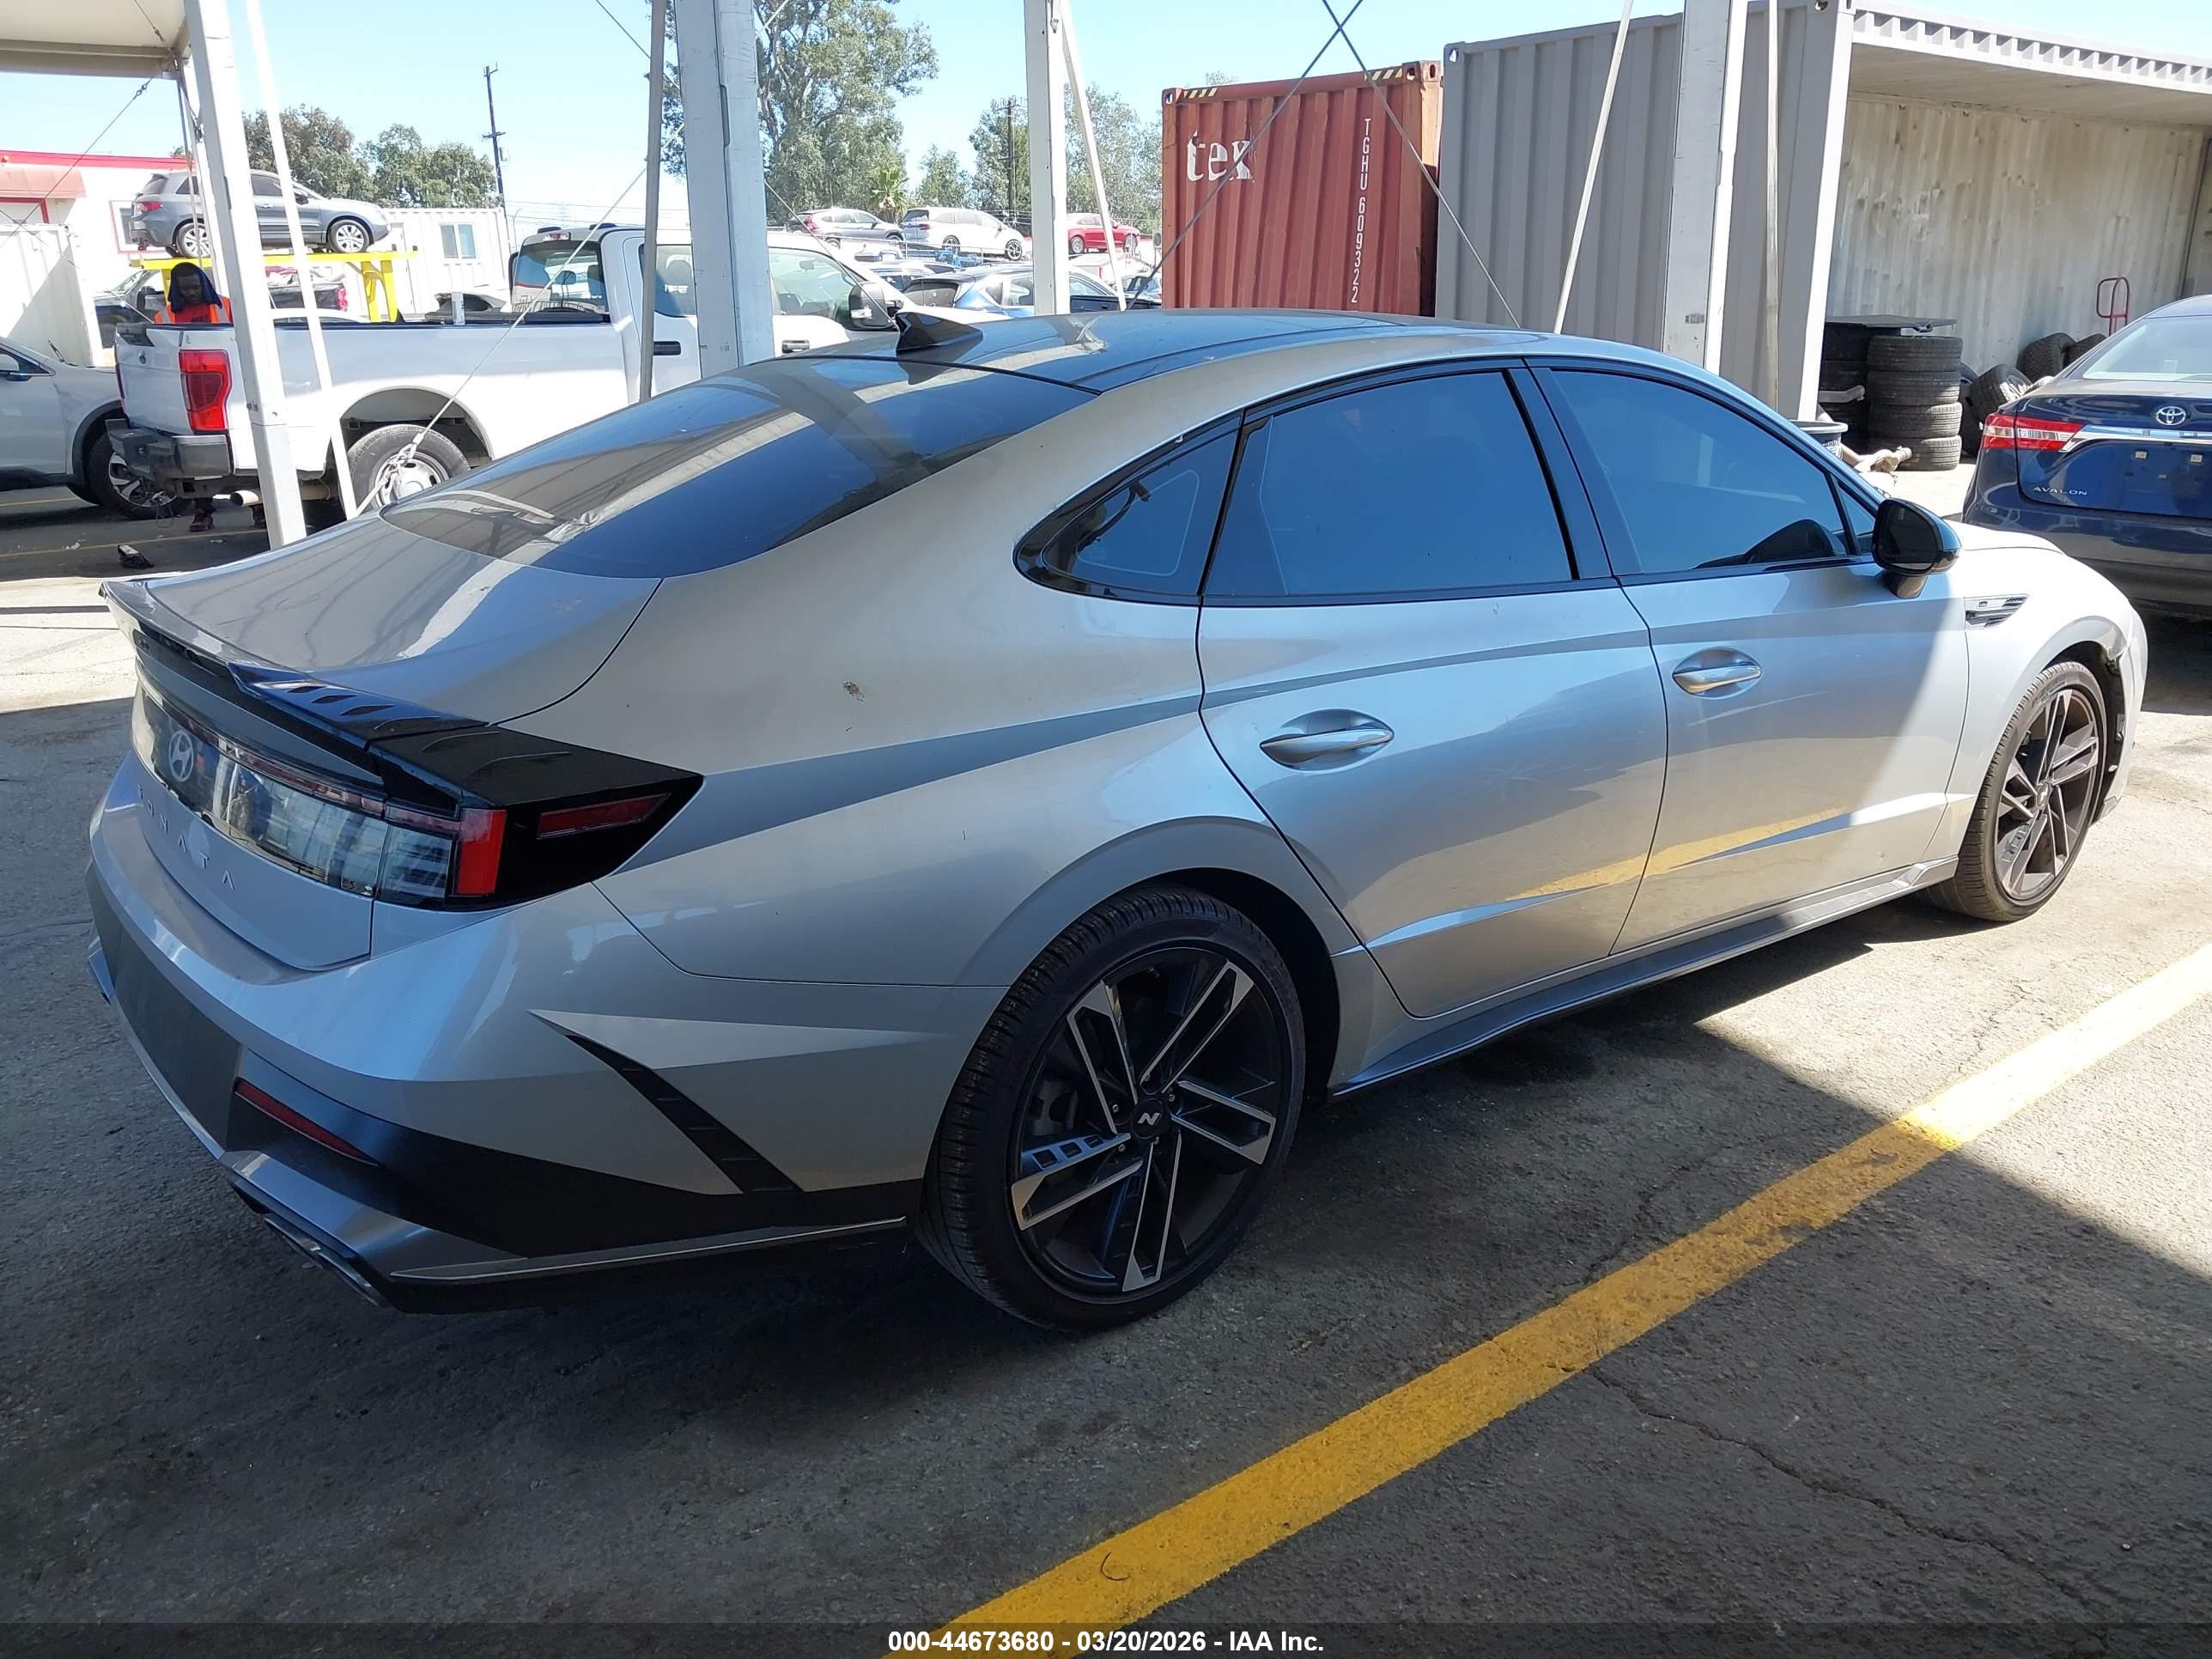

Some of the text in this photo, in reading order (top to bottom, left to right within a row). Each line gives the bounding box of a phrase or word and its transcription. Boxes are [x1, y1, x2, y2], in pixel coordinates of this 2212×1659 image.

[1187, 130, 1252, 182] tex
[1351, 118, 1372, 303] TGHU 609322
[2033, 486, 2087, 495] AVALON
[137, 783, 235, 890] SONATA
